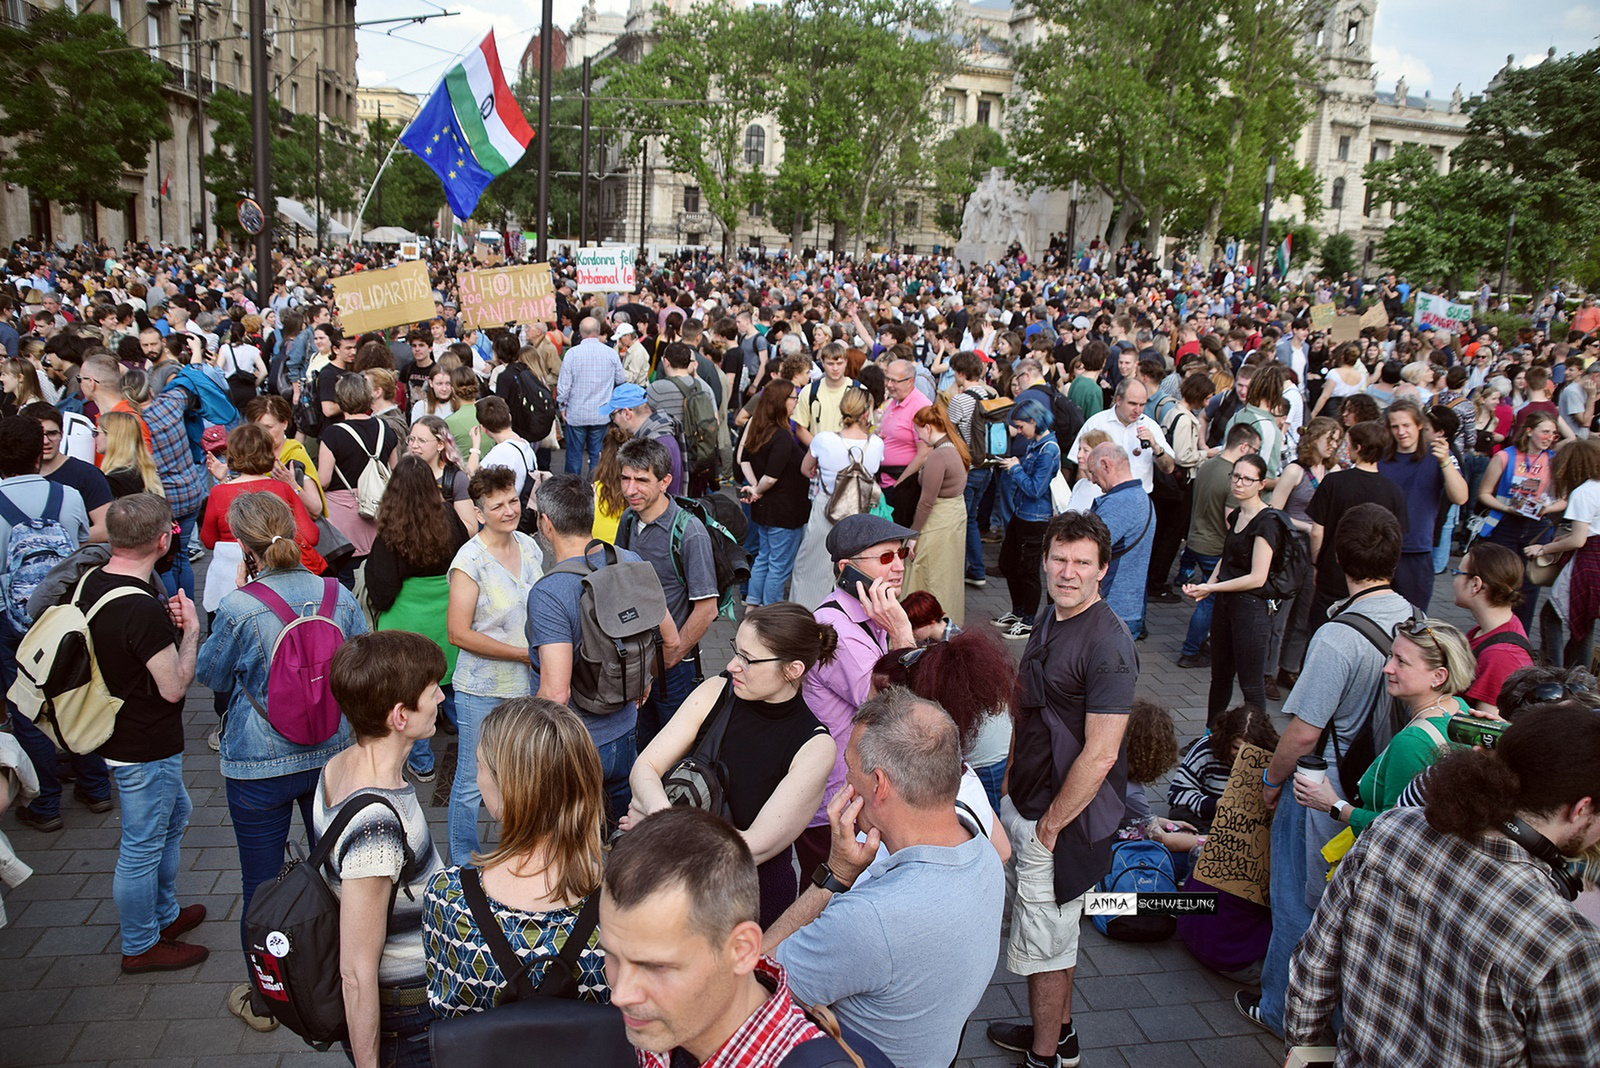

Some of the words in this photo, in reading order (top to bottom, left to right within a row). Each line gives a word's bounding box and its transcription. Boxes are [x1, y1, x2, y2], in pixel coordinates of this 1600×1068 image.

[575, 250, 616, 266] Kordonra
[619, 248, 636, 270] fel!
[459, 273, 477, 295] KI
[480, 271, 550, 300] HOLNAP
[576, 266, 620, 285] Orbánnal
[623, 266, 636, 287] le!
[335, 268, 429, 318] SZOLIDARITÁS
[461, 292, 482, 307] FOG
[462, 294, 555, 328] TANÍTANI?
[1417, 296, 1433, 311] JE
[1446, 304, 1472, 322] SUIS
